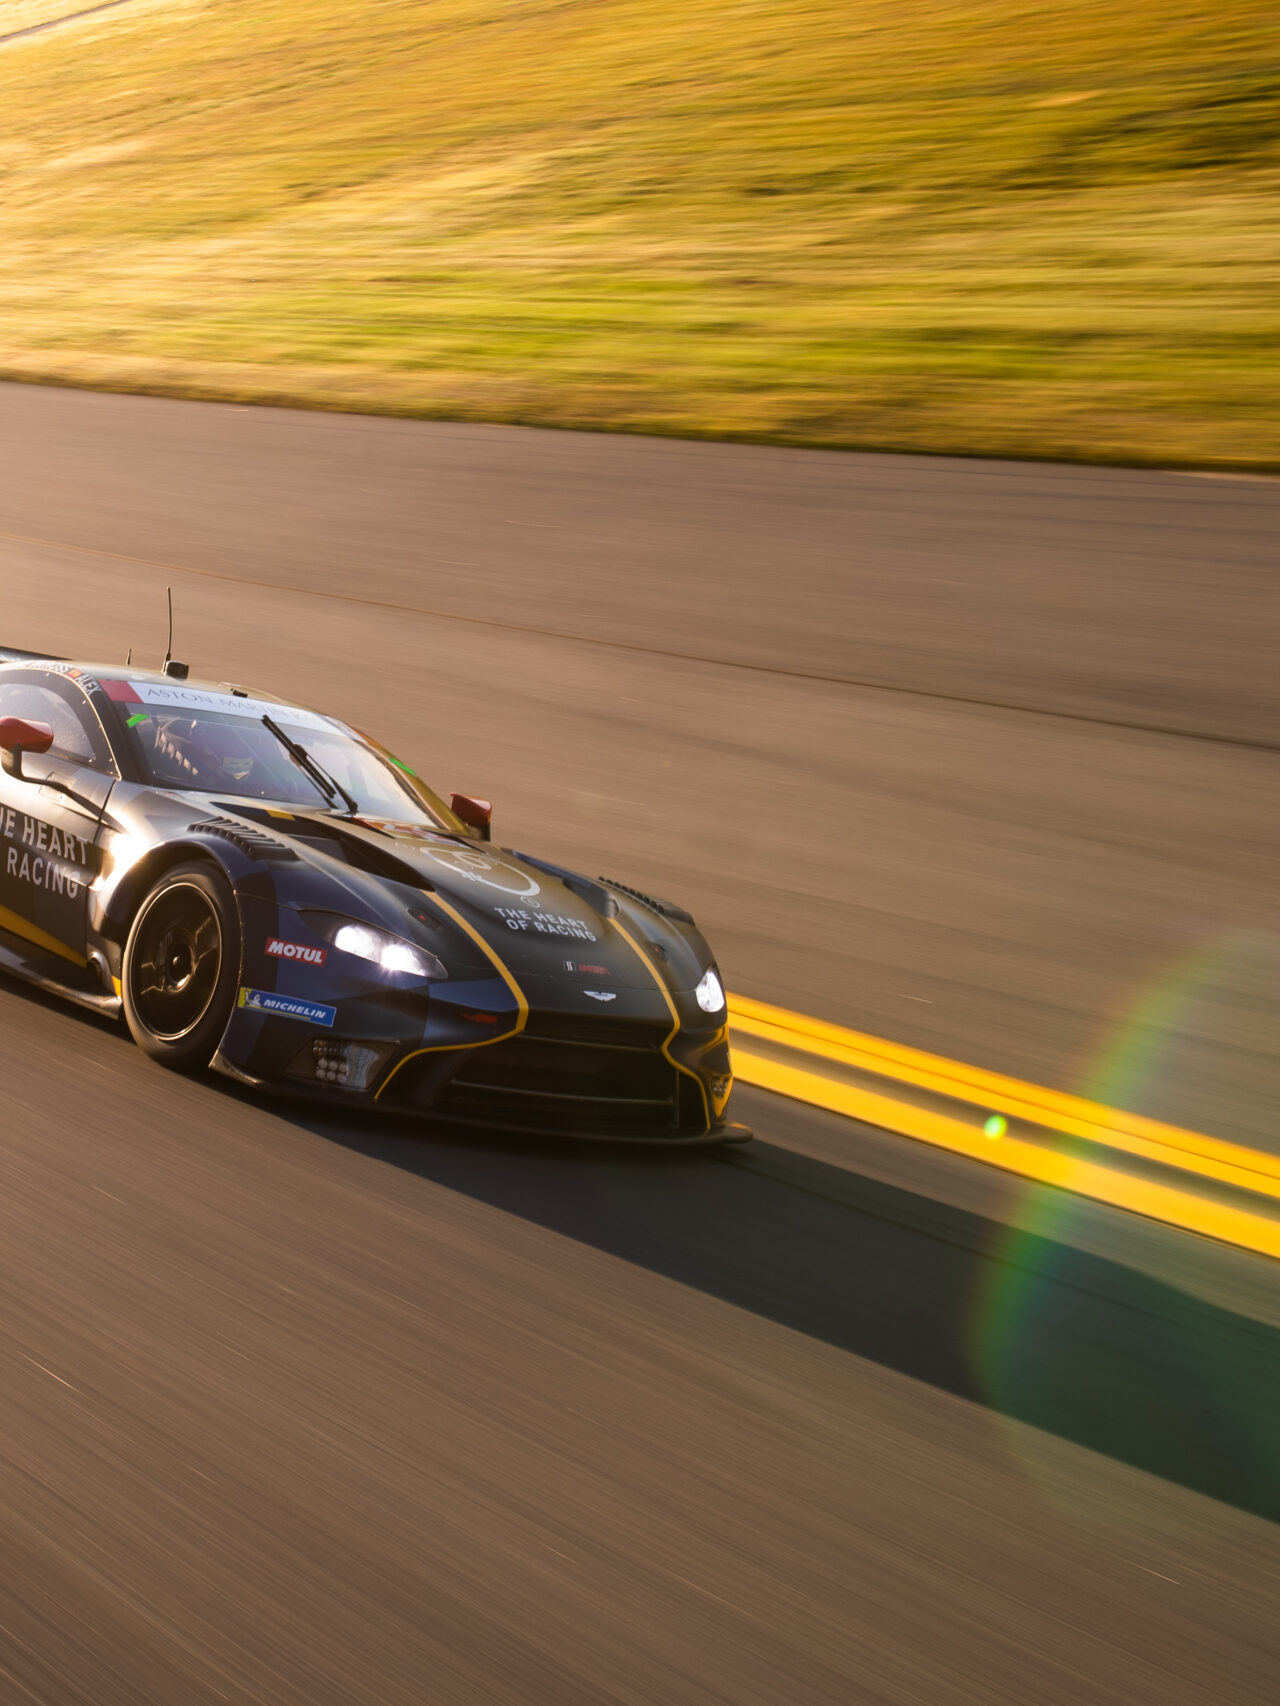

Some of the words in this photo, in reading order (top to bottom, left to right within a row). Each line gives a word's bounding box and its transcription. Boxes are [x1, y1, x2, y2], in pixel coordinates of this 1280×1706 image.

[74, 673, 102, 698] ALEX
[147, 688, 212, 705] ASTON
[22, 816, 89, 865] HEART
[6, 847, 81, 899] RACING
[494, 907, 531, 920] THE
[533, 912, 588, 930] HEART
[506, 919, 528, 930] OF
[533, 921, 597, 942] RACING
[268, 941, 322, 963] MOTUL
[263, 999, 326, 1019] MICHELIN
